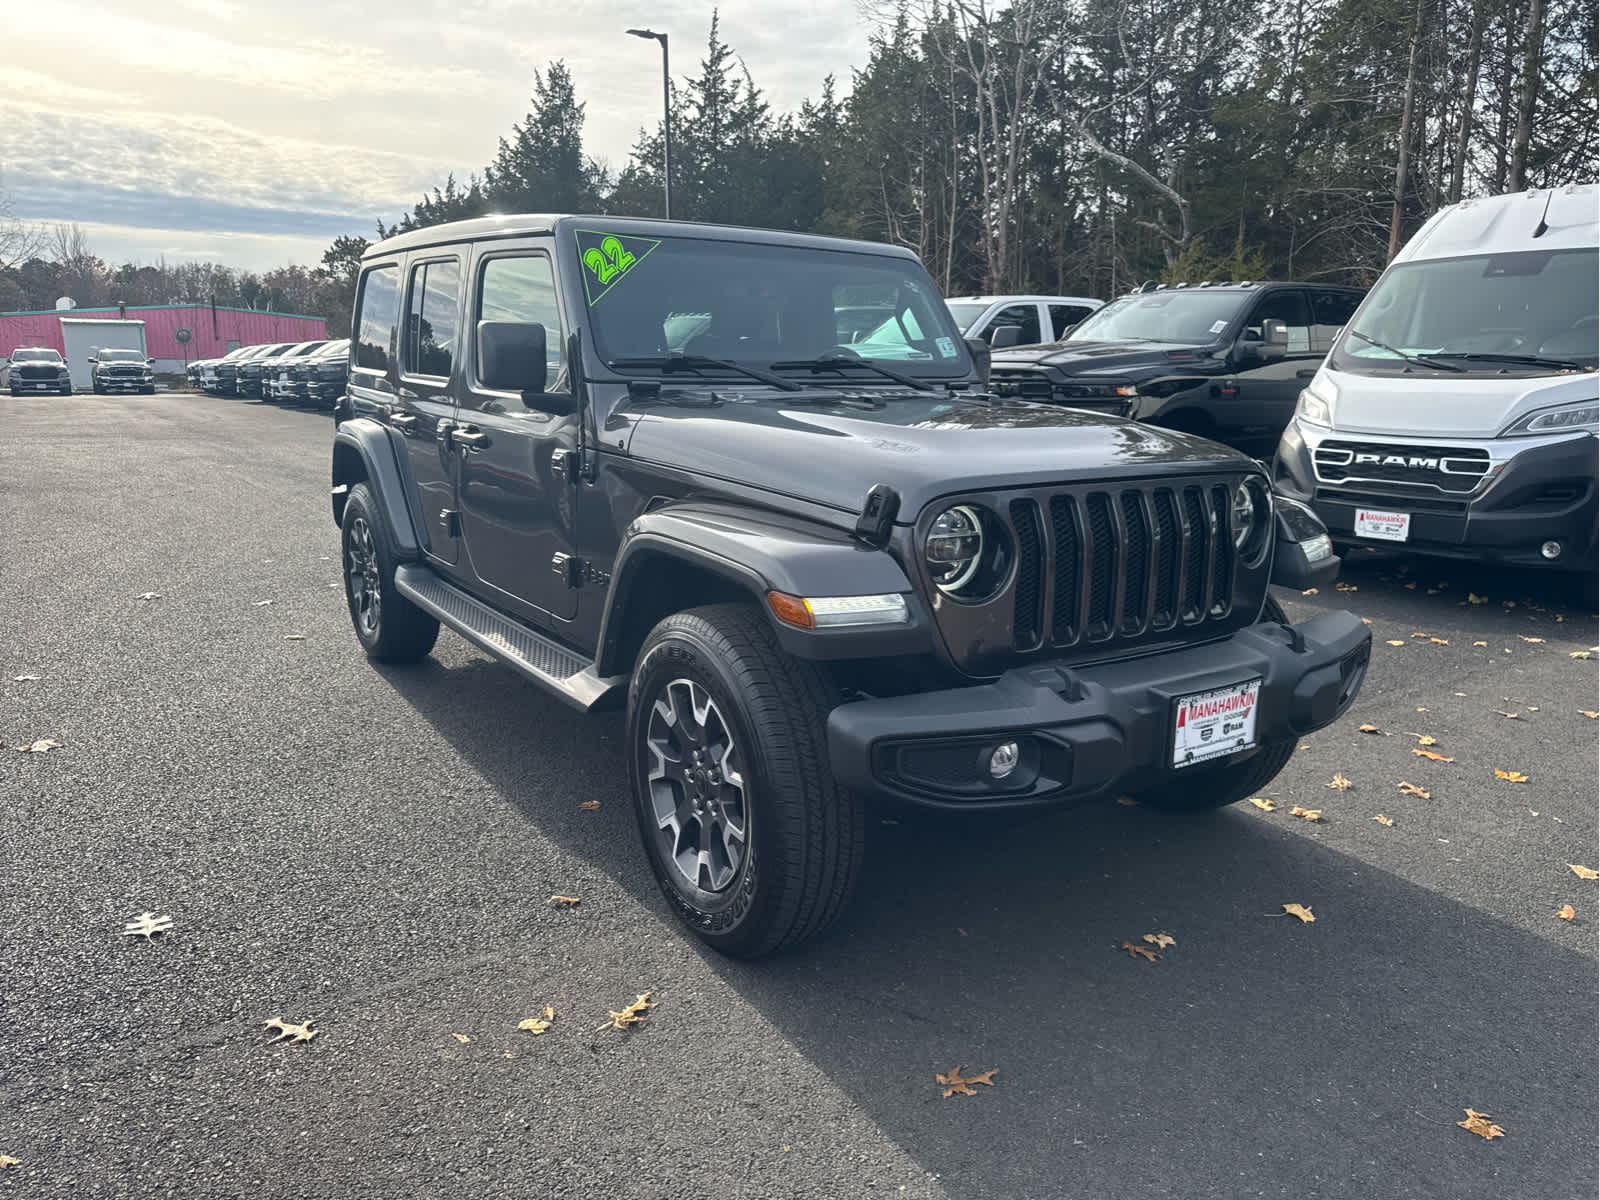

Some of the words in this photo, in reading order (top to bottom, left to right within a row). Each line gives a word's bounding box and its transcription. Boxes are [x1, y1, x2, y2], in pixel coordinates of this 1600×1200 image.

[583, 236, 636, 285] 22
[1355, 454, 1438, 470] RAM
[1188, 691, 1257, 721] MANAHAWKIN
[1230, 722, 1244, 732] RAM
